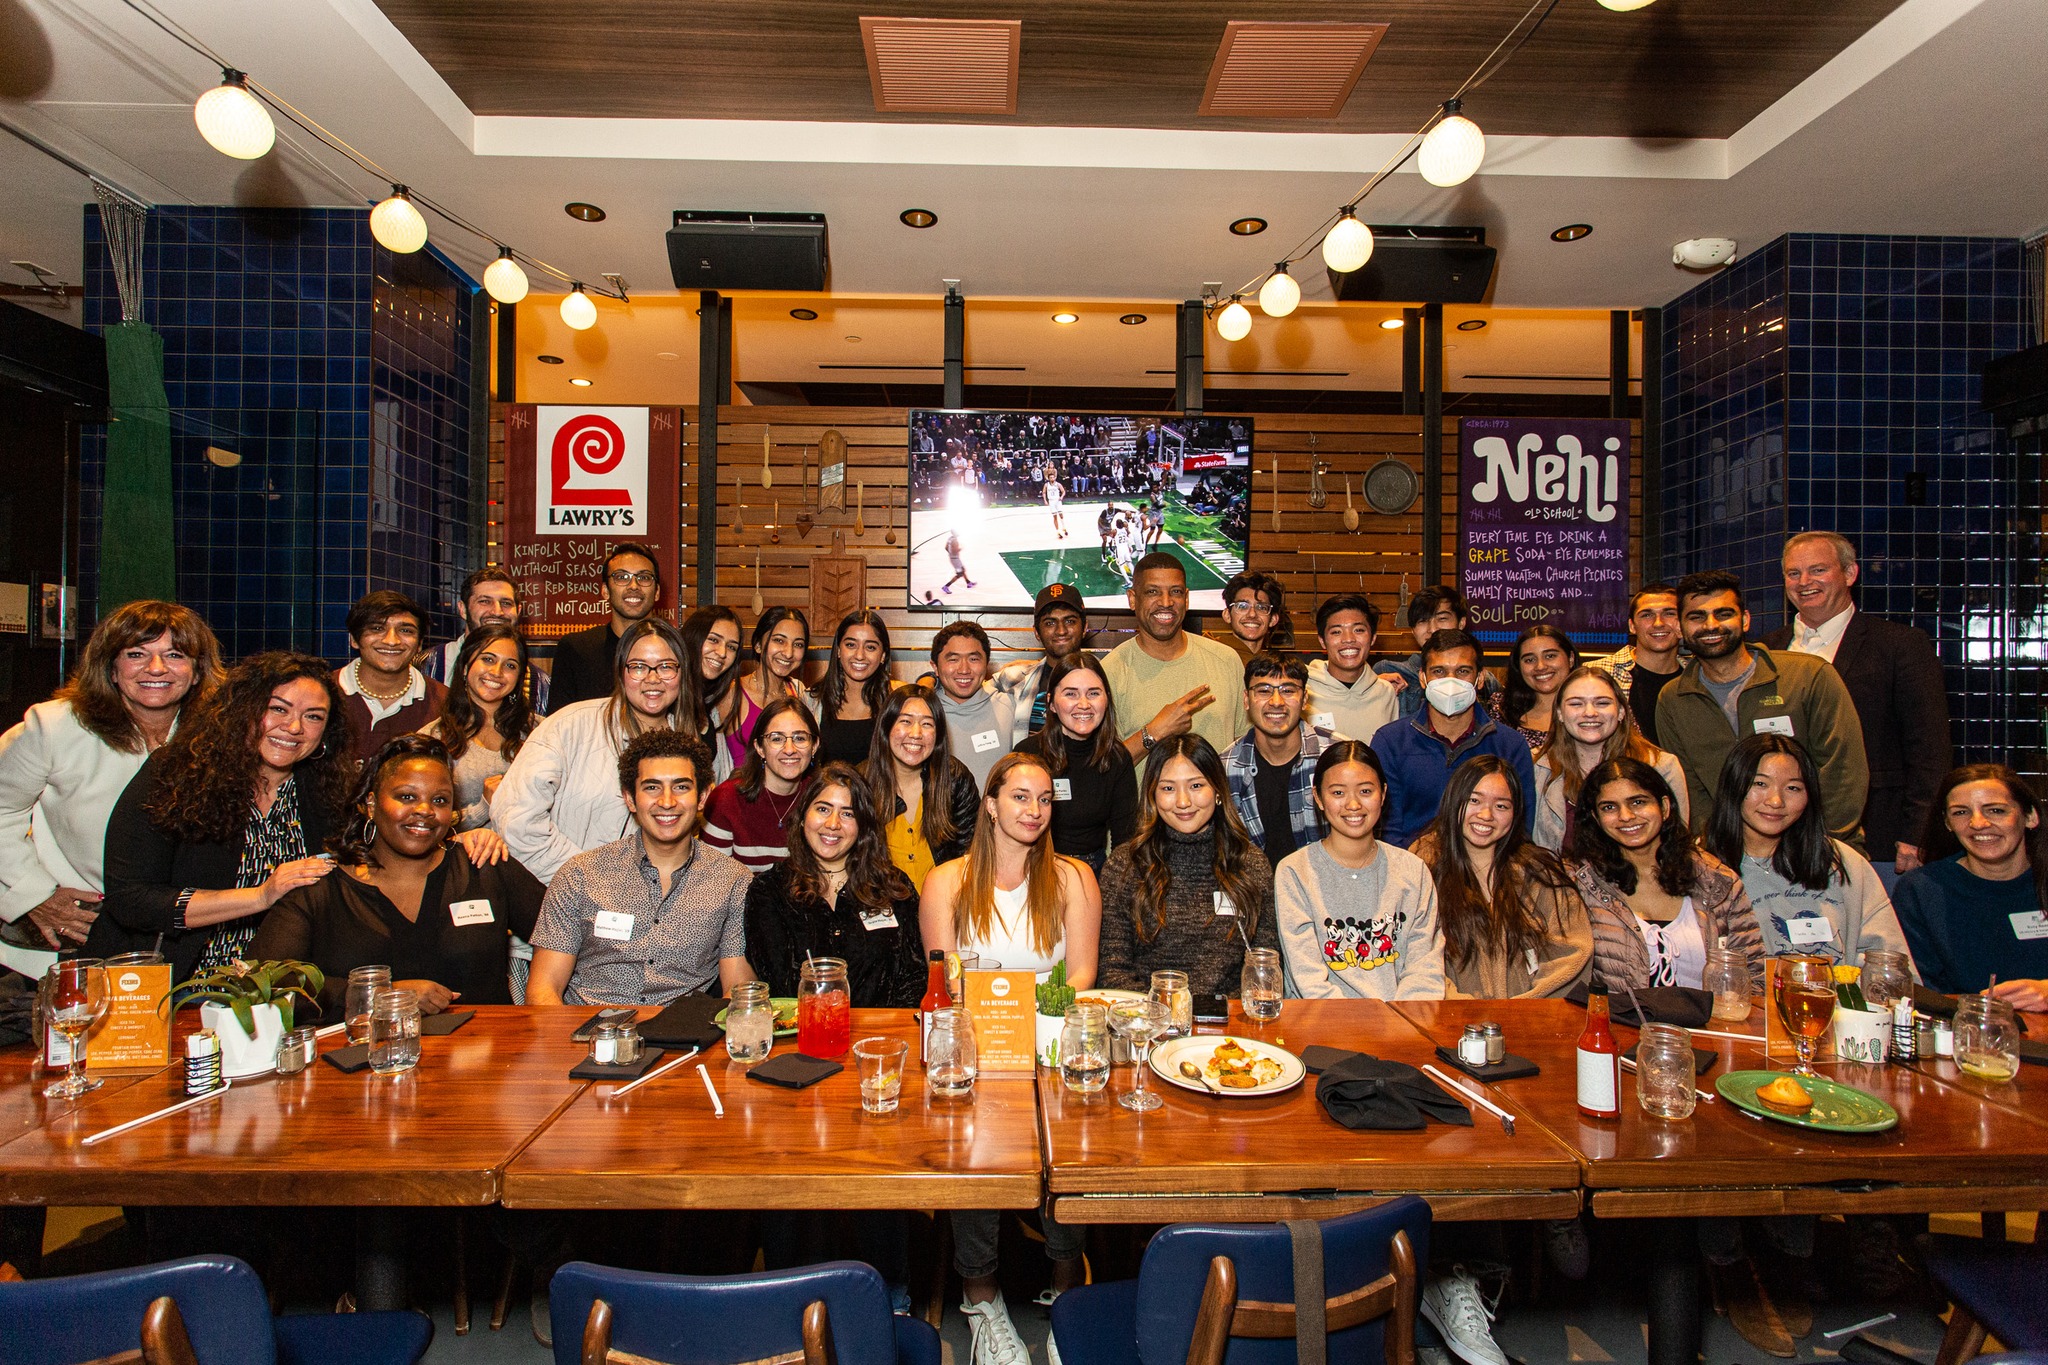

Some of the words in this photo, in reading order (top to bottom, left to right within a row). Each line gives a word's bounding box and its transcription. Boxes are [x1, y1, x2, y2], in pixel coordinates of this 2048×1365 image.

[1471, 432, 1621, 522] Nehi
[549, 508, 635, 526] LAWRY'S
[1524, 508, 1541, 519] OLD
[1543, 506, 1579, 520] SCHOOL
[1469, 529, 1501, 544] EVERY
[1504, 530, 1529, 543] TIME
[1535, 531, 1554, 544] EYE
[1559, 530, 1594, 543] DRINK
[1598, 529, 1607, 542] A
[513, 542, 561, 558] KINFOLK
[568, 539, 602, 560] SOUL
[1468, 547, 1510, 564] GRAPE
[1555, 546, 1572, 560] EYE
[1575, 547, 1623, 562] REMEMBER
[510, 560, 563, 577] WITHOUT
[565, 562, 603, 578] SEASO
[1465, 569, 1503, 582] SUMMER
[1546, 566, 1581, 582] CHURCH
[1583, 566, 1623, 582] PICNICS
[518, 581, 540, 596] IKE
[545, 580, 565, 595] RED
[566, 580, 600, 595] BEANS
[1466, 584, 1503, 600] FAMILY
[1506, 586, 1555, 601] REUNIONS
[521, 597, 548, 621] ICE!
[555, 600, 578, 615] NOT
[578, 599, 612, 615] QUITE
[1470, 603, 1513, 625] SOUL
[1514, 604, 1550, 623] FOOD
[1588, 611, 1621, 629] AMEN
[1784, 887, 1808, 898] think
